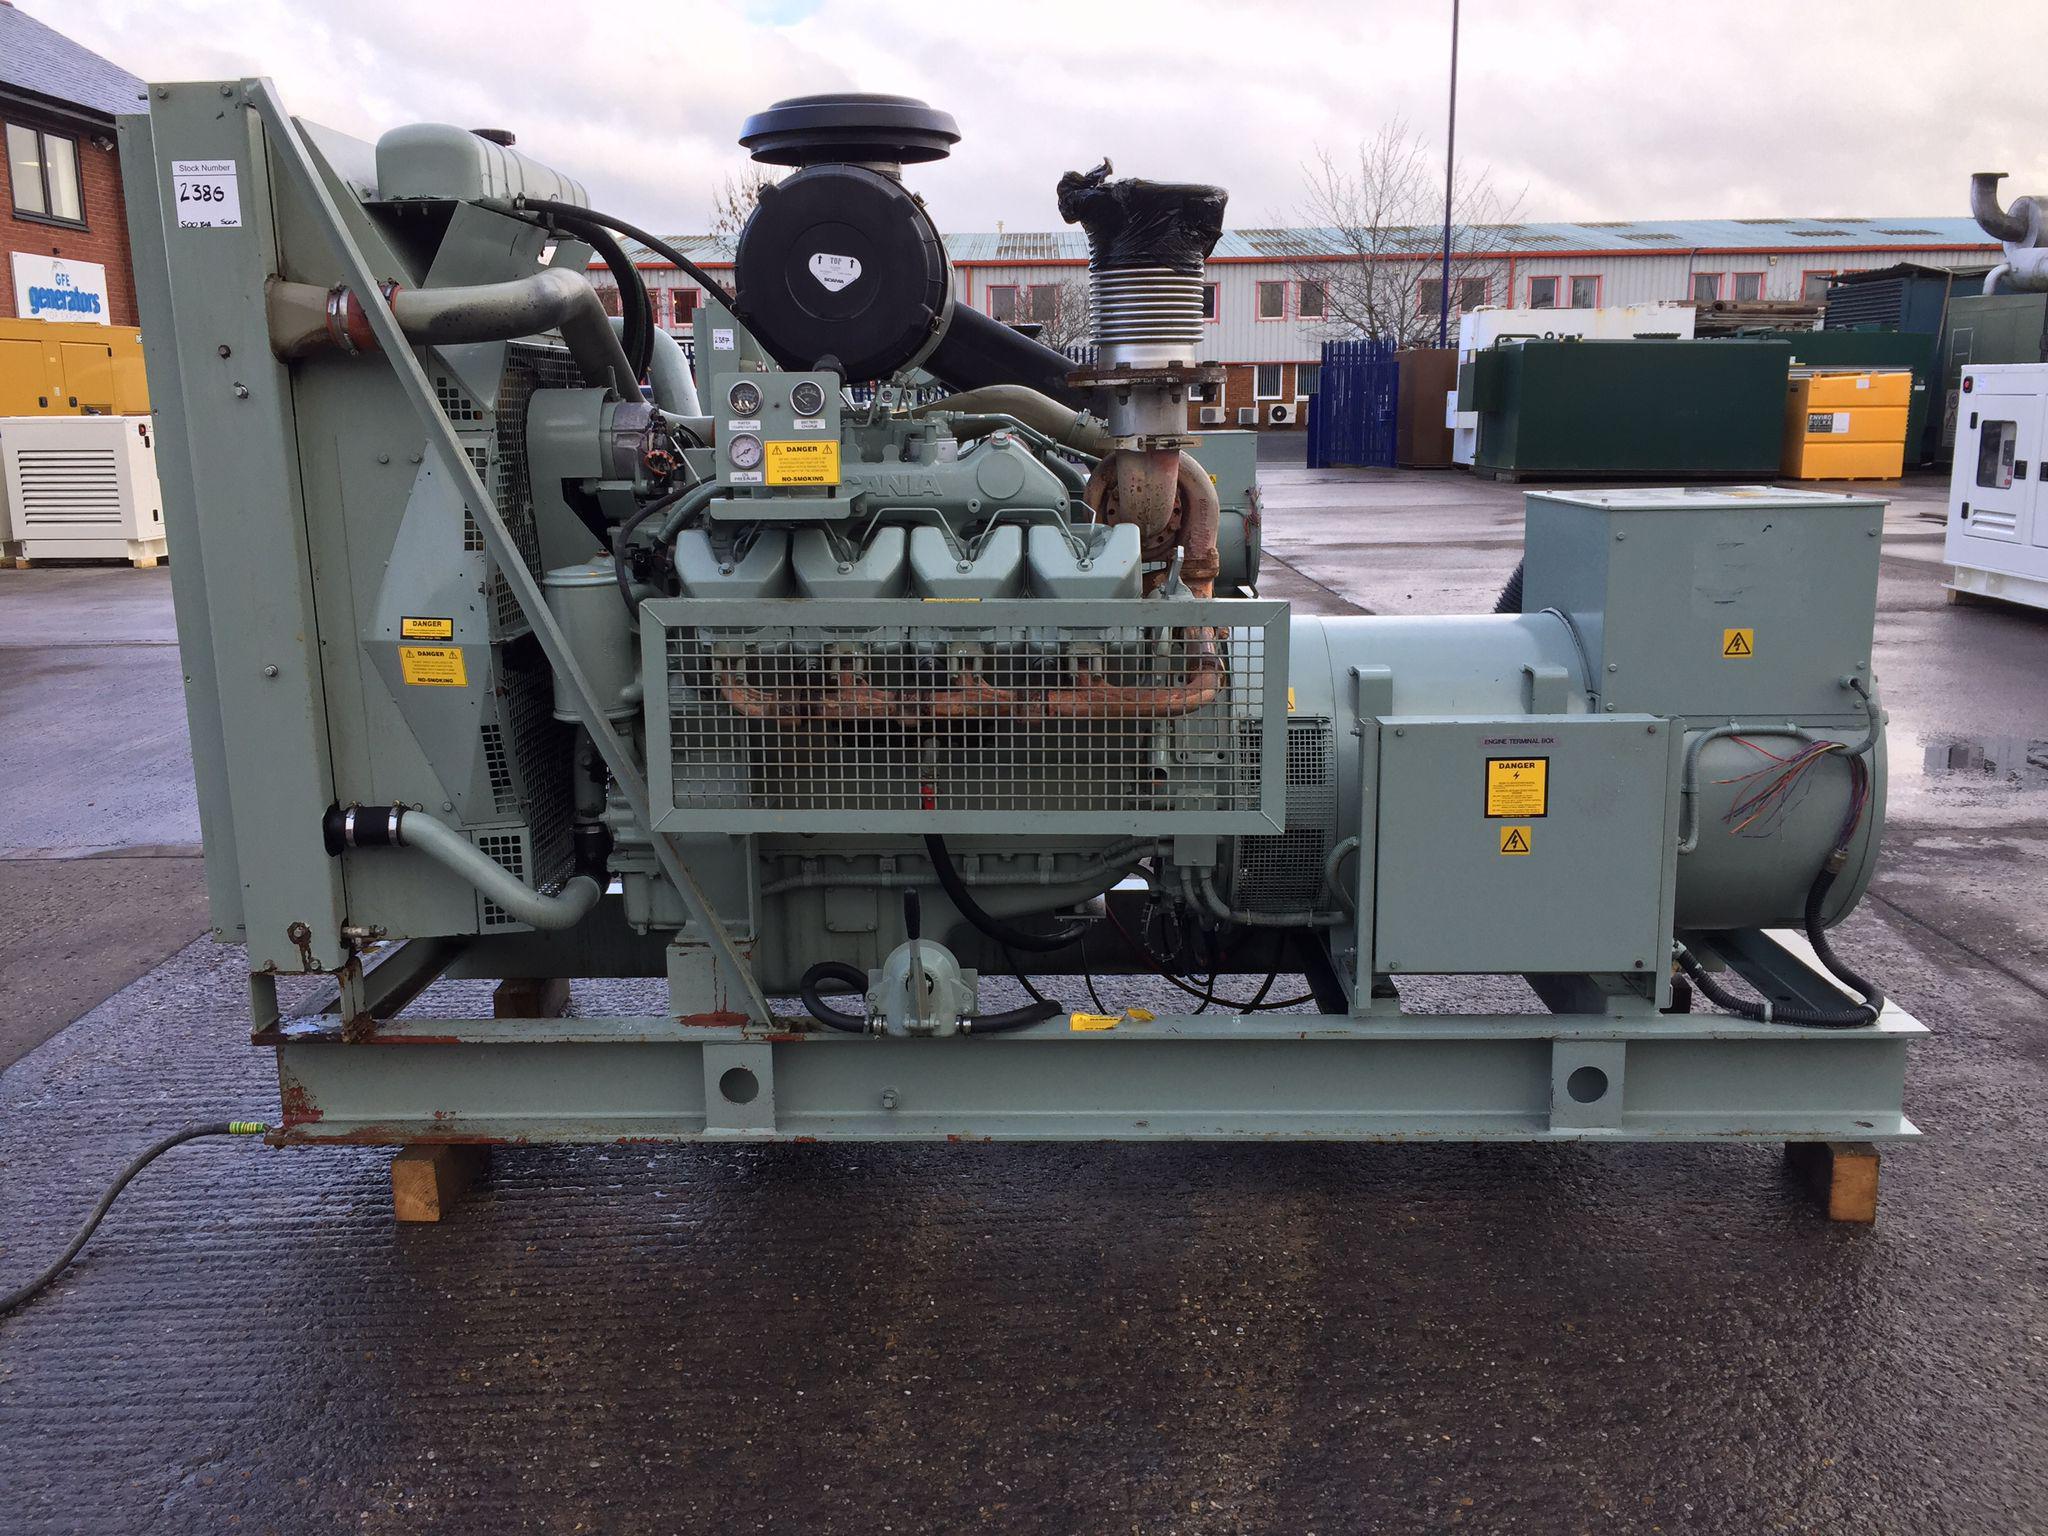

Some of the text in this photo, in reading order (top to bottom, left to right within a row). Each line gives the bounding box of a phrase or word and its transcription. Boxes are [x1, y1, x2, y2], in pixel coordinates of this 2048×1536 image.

[179, 164, 230, 172] Stock Number
[830, 257, 842, 265] TOP
[55, 272, 71, 287] GFE
[29, 286, 101, 314] generators
[1509, 737, 1541, 745] TERMINAL
